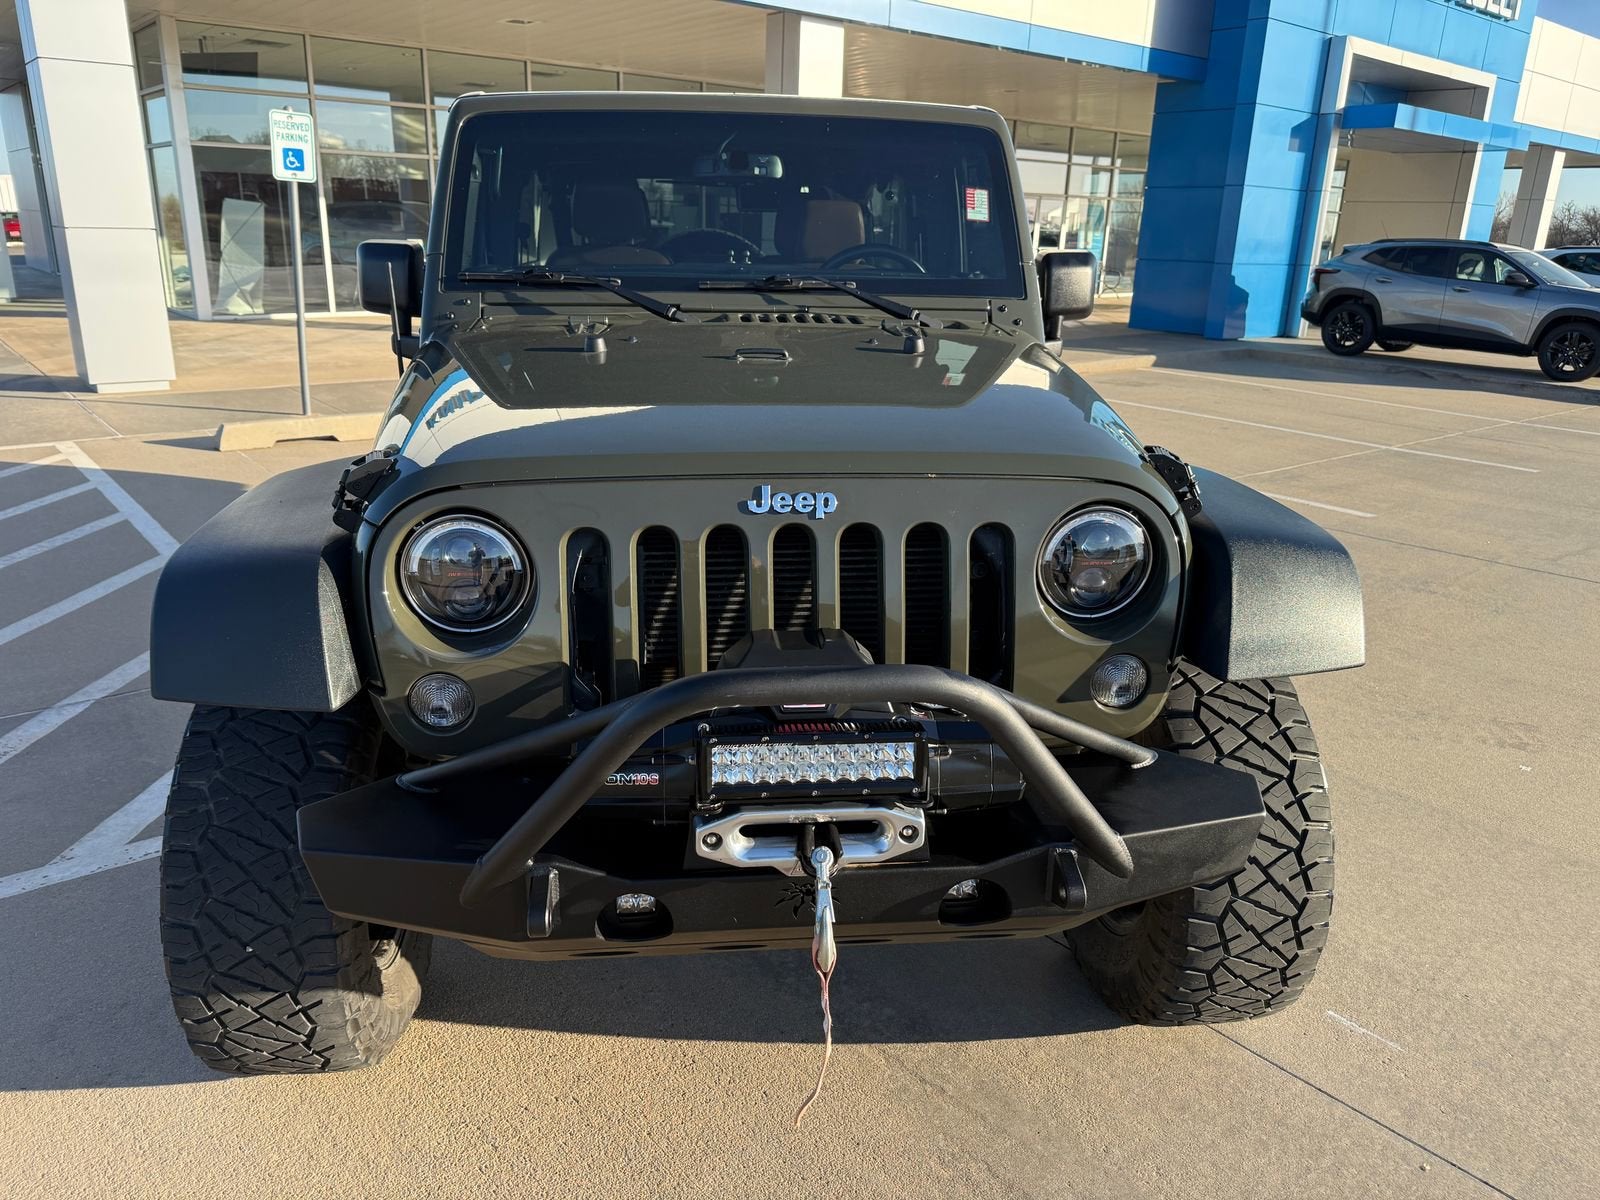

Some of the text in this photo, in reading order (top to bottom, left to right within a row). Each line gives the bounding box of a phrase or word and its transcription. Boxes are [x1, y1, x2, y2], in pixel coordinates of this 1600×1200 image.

[273, 120, 310, 132] RESERVED
[276, 131, 309, 144] PARKING
[747, 484, 838, 519] Jeep
